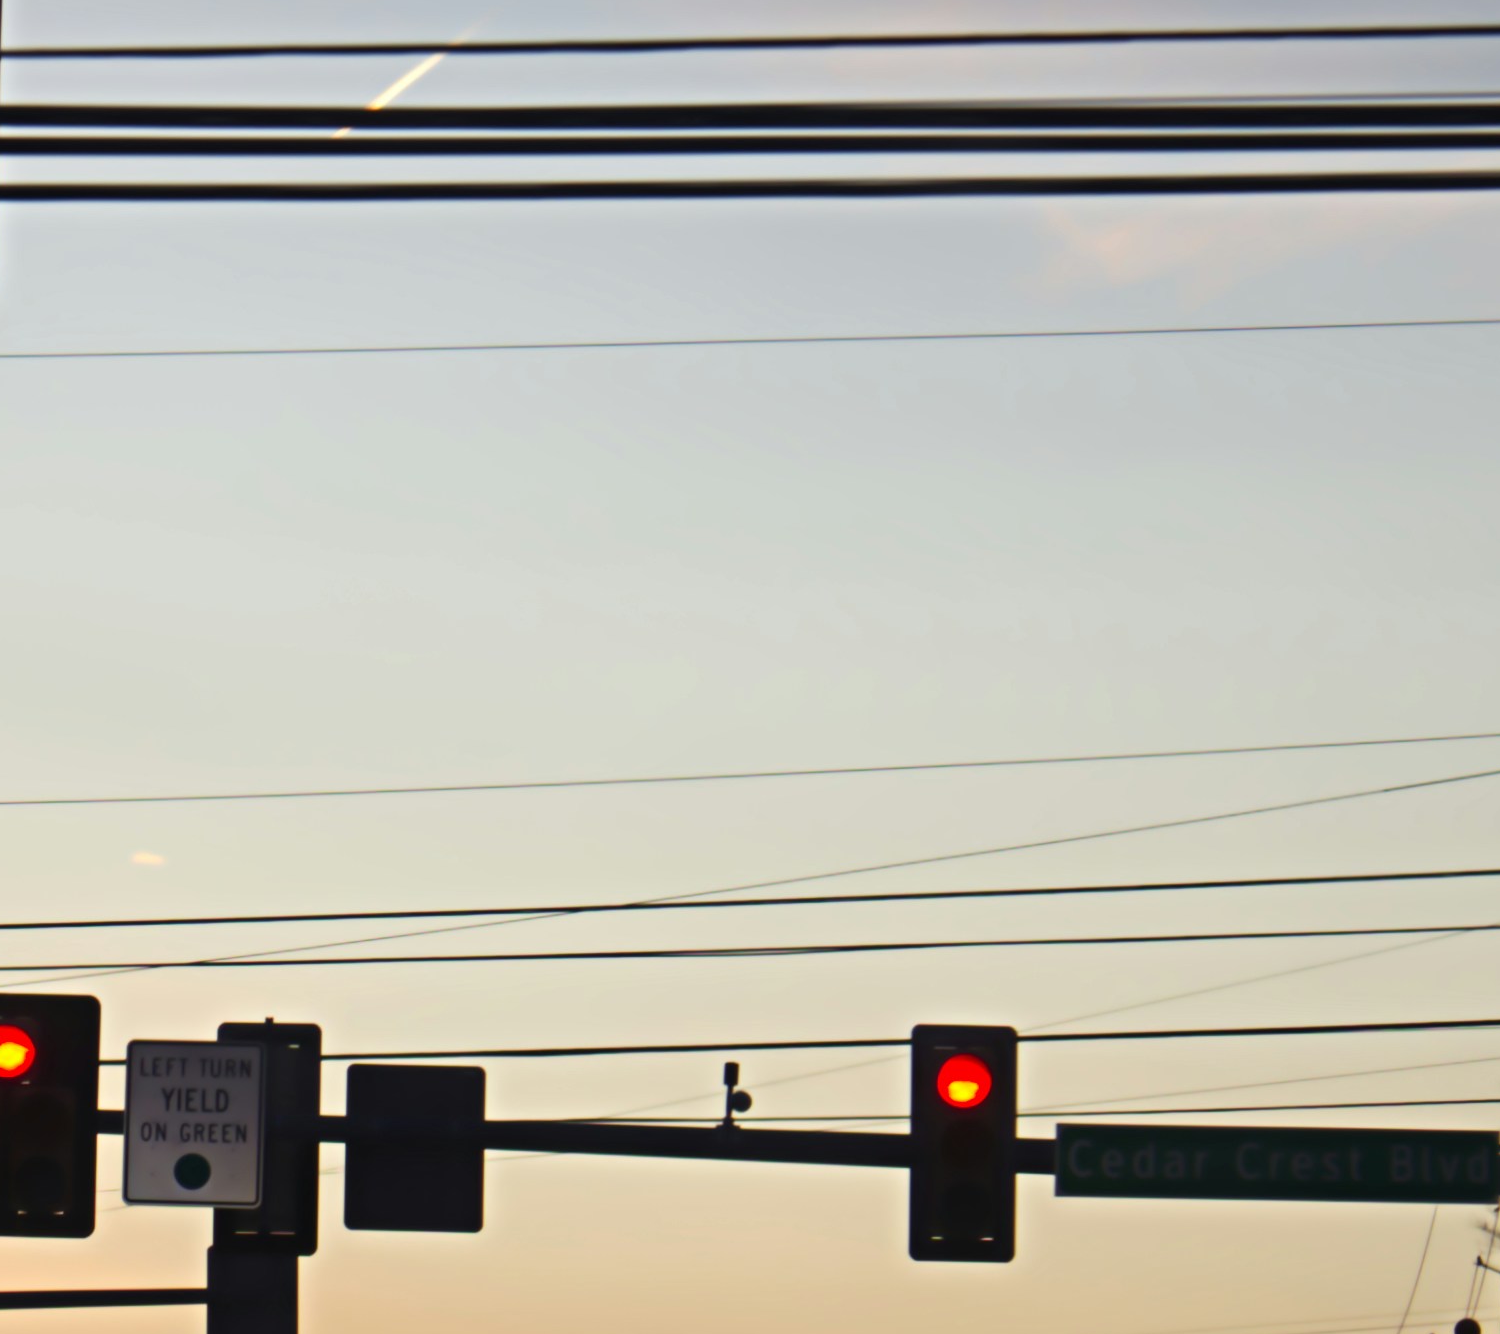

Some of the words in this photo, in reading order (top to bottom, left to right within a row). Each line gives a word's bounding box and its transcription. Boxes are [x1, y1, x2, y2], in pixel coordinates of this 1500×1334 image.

[140, 1057, 187, 1078] LEFT
[200, 1058, 253, 1079] TURN
[162, 1087, 230, 1113] YIELD
[140, 1122, 167, 1142] ON
[179, 1123, 248, 1144] GREEN
[1067, 1138, 1211, 1181] Cedar
[1235, 1141, 1368, 1184] Crest
[1387, 1143, 1490, 1186] Blvd
